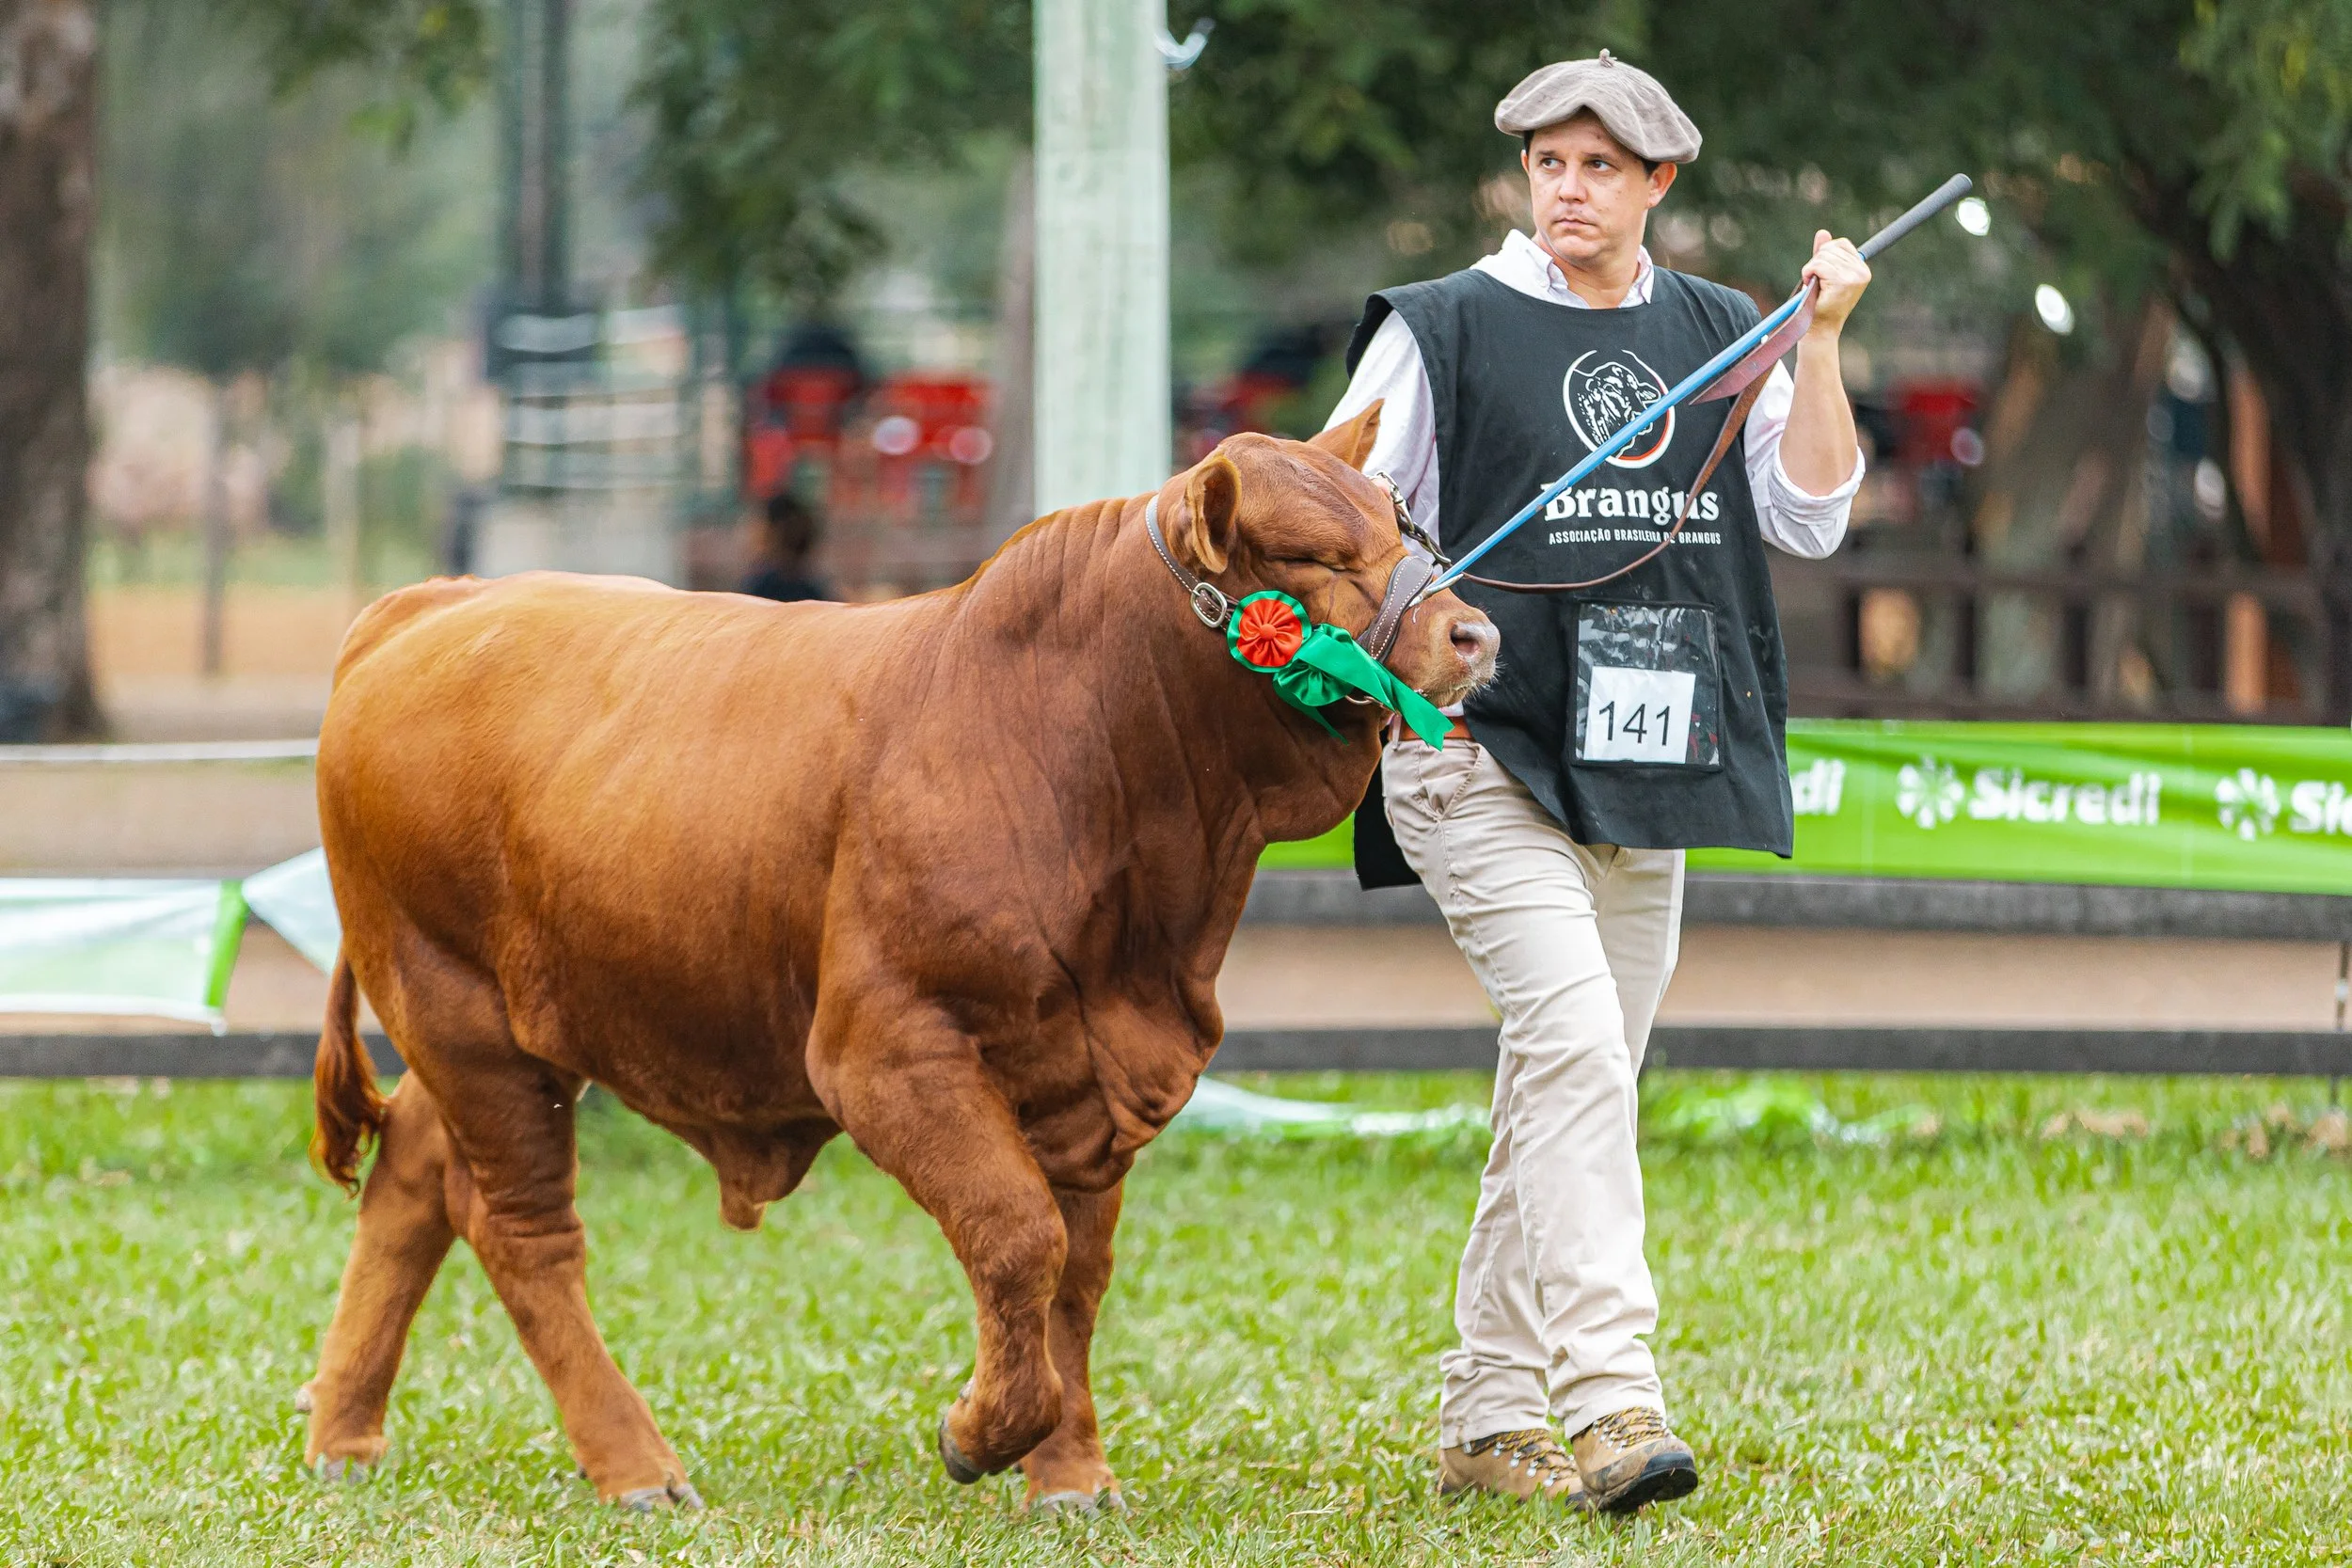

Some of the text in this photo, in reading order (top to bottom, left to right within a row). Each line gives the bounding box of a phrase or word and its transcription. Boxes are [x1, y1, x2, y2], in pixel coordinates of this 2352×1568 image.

[1540, 482, 1720, 526] Brangus
[1549, 528, 1612, 546] ASSOCIAÇÃO
[1613, 529, 1661, 543] BRASILEIRA
[1677, 531, 1722, 545] BRANGUS
[1598, 700, 1671, 747] 141
[1967, 767, 2162, 827] Sicredi
